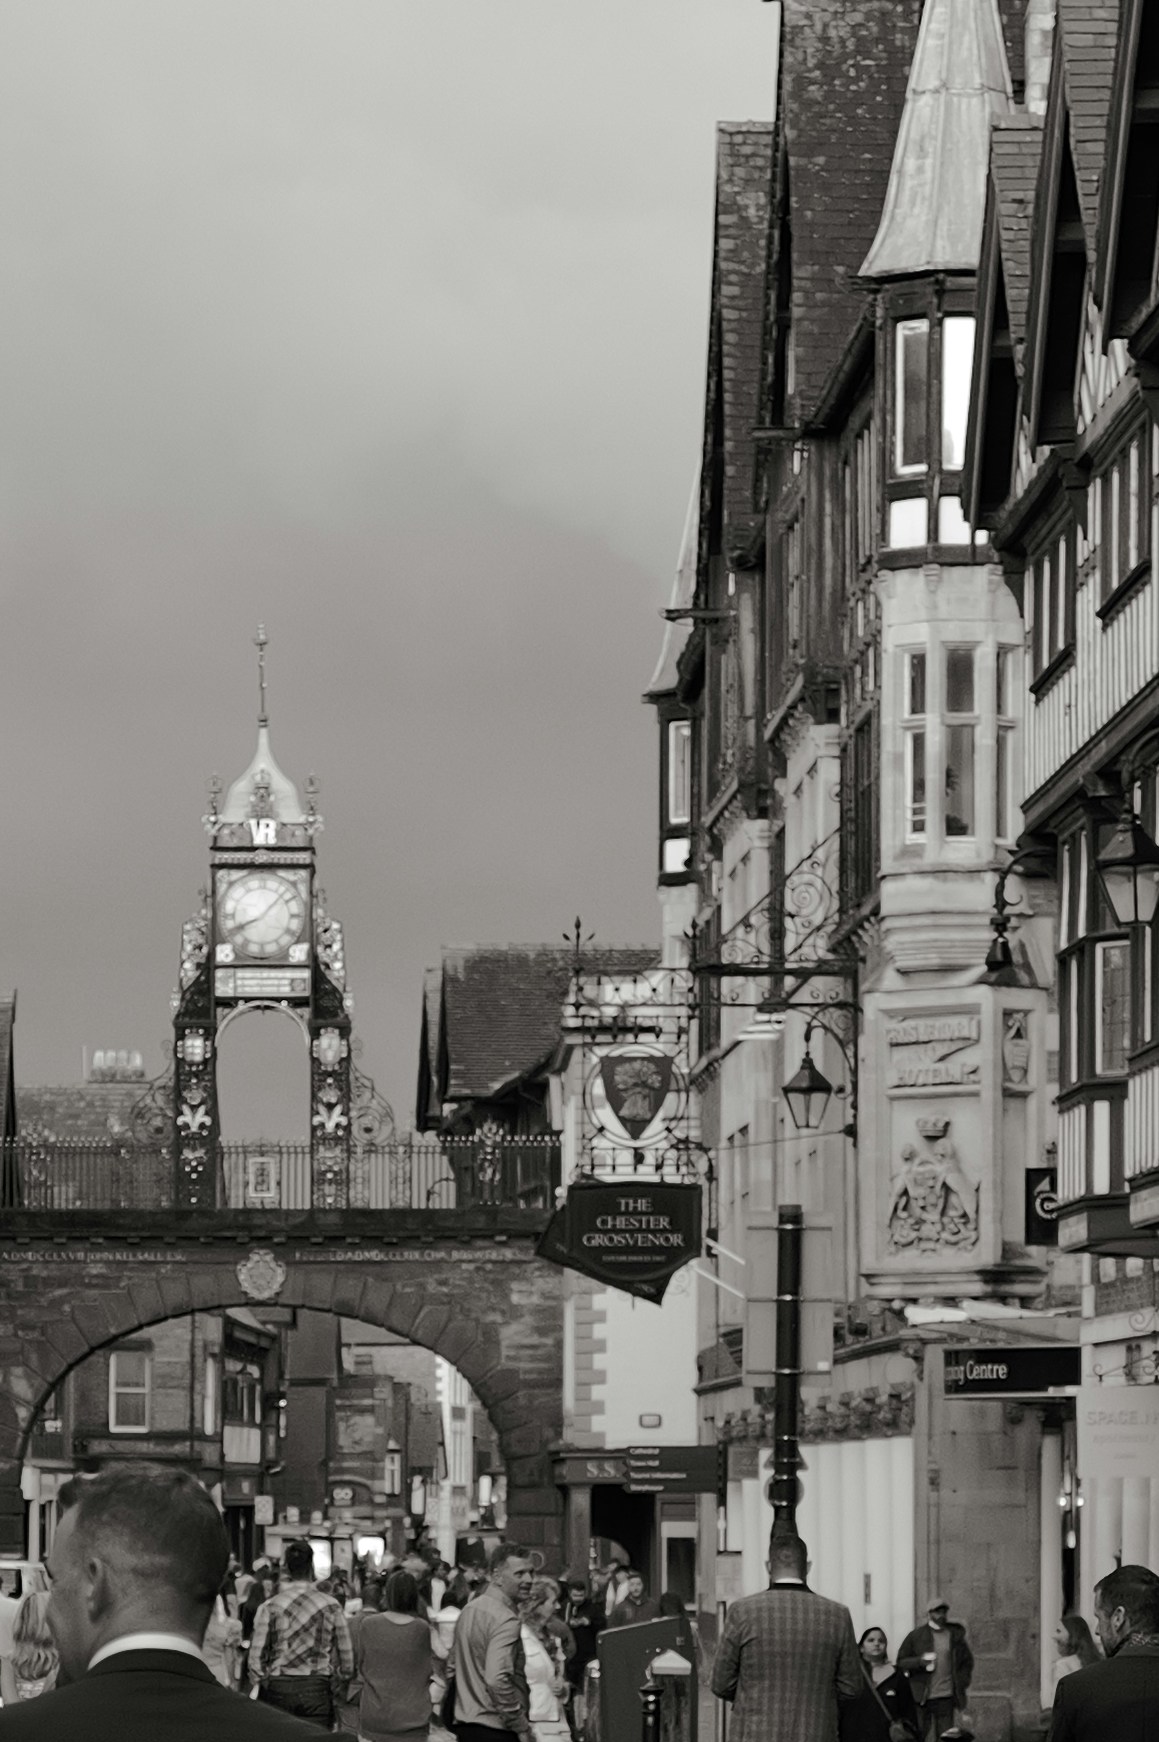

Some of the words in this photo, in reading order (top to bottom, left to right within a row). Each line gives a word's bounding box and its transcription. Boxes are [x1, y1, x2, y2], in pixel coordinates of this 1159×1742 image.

[617, 1197, 653, 1212] THE
[596, 1215, 671, 1230] CHESTER
[582, 1233, 685, 1247] GROSVENOR
[966, 1360, 1007, 1380] Centre
